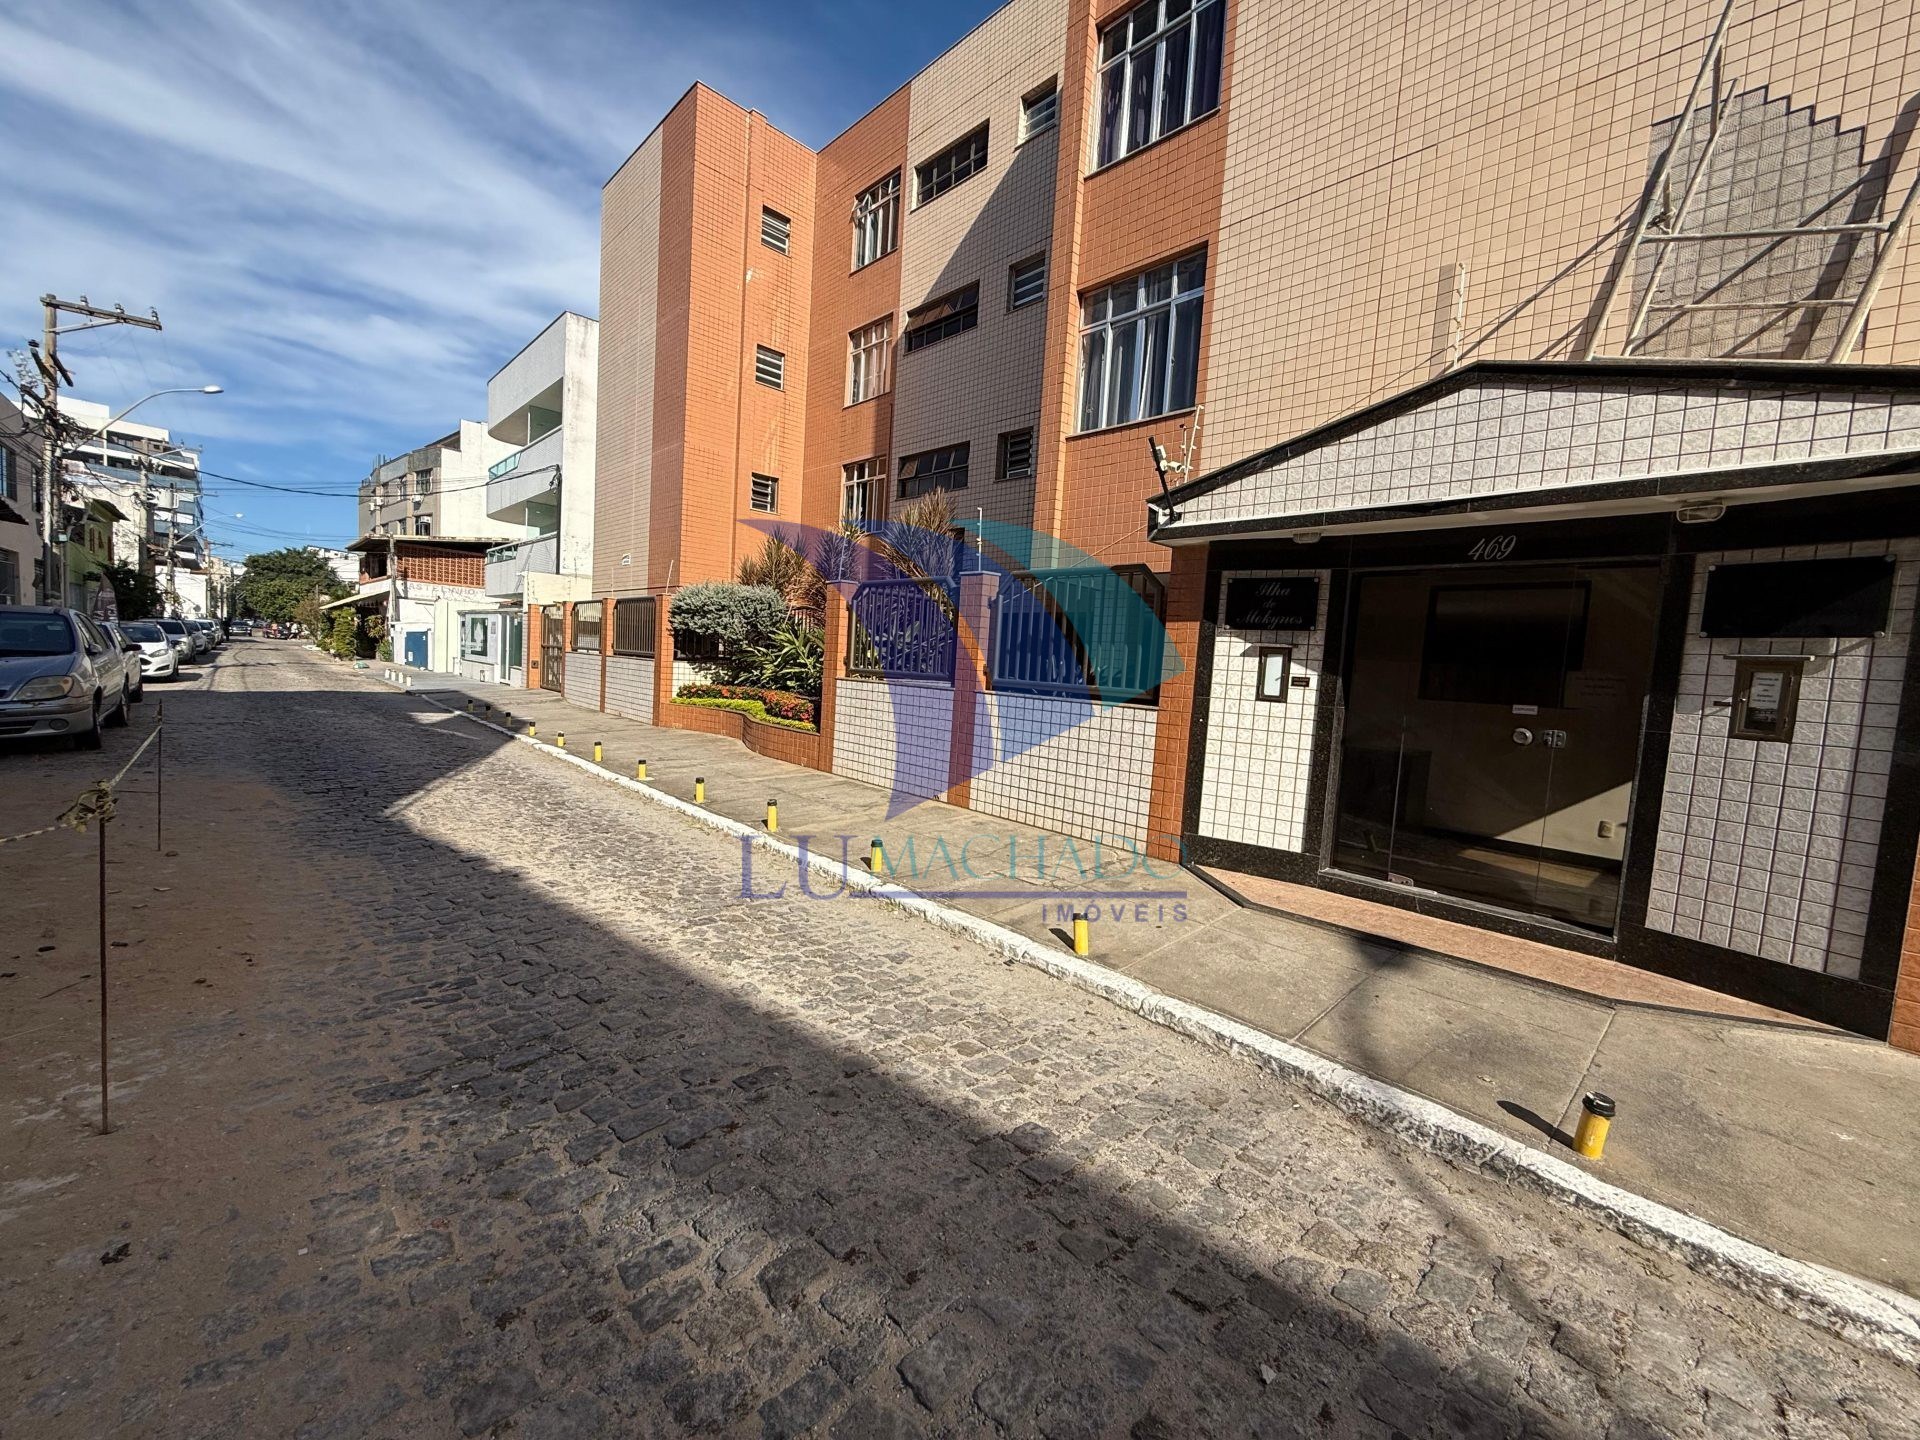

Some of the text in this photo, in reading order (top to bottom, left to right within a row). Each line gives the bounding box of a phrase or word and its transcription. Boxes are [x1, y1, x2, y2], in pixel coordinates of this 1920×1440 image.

[1468, 534, 1517, 561] 469
[1255, 581, 1291, 597] Ilha
[1262, 598, 1277, 609] de
